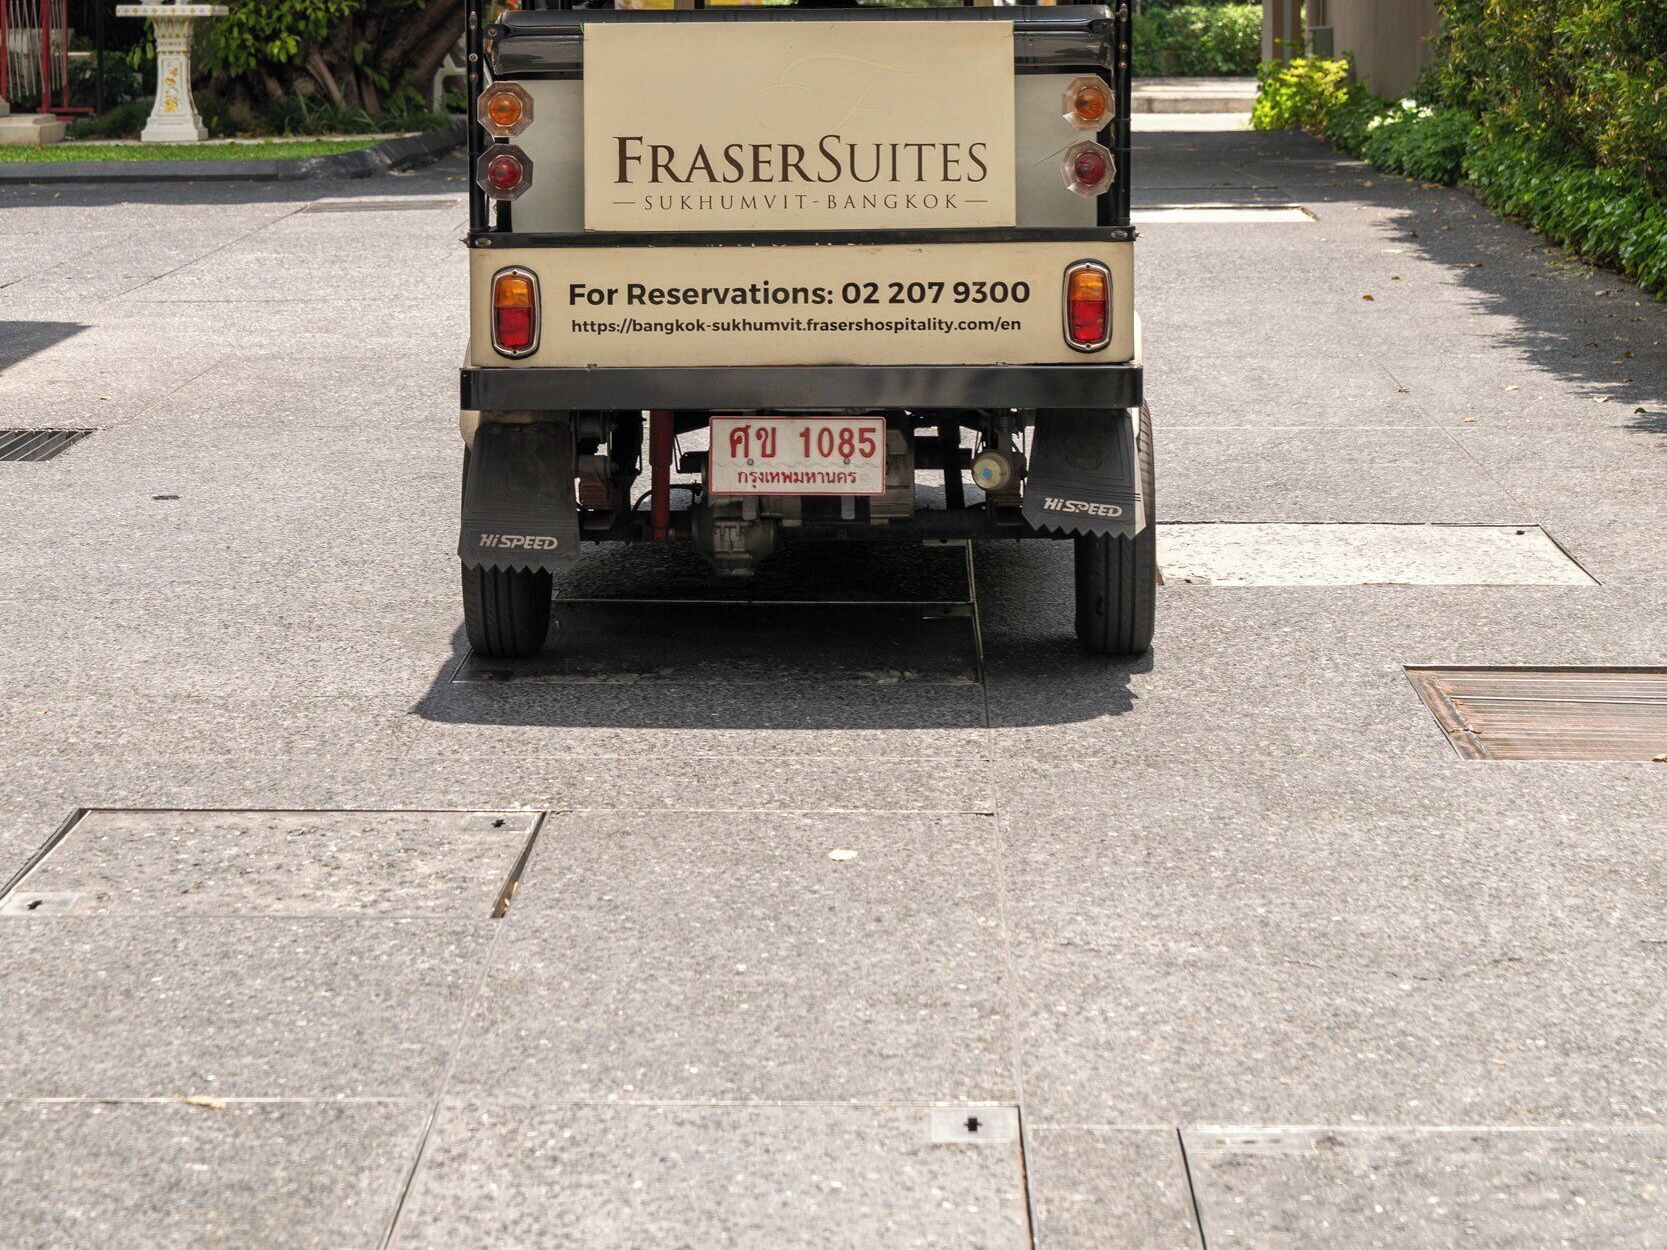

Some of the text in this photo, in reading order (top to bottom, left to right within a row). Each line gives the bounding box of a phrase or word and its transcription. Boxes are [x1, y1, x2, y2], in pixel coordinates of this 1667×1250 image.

[568, 280, 1031, 306] For Reservations: 02 207 9300
[571, 316, 1022, 335] https://bangkok-sukhumvit.frasershospitality.com/en
[799, 426, 877, 459] 1085
[737, 470, 857, 489] กรุงเทพมหานคร
